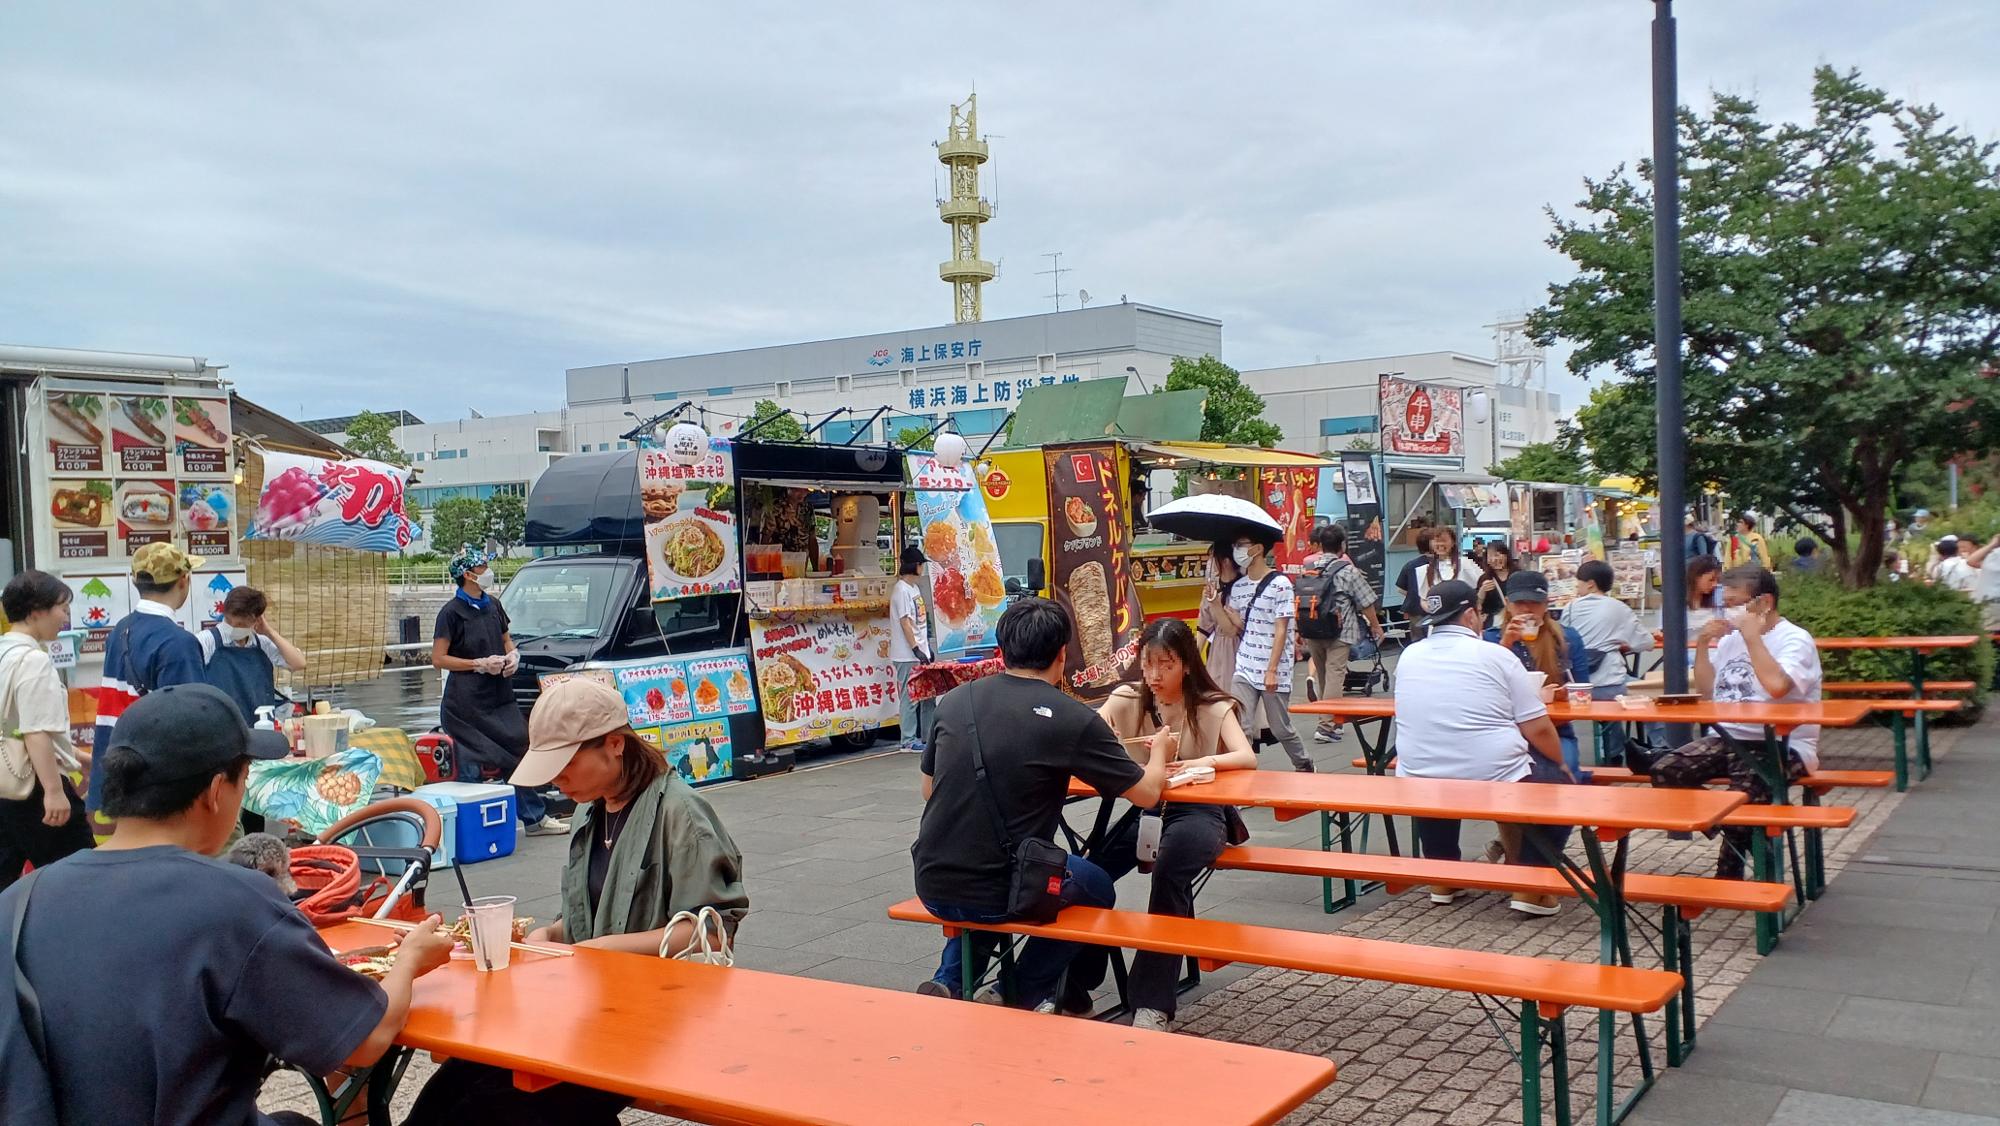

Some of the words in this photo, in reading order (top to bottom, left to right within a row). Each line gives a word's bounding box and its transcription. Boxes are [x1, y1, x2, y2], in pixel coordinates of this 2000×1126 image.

[872, 349, 889, 358] JCG
[900, 338, 983, 364] 海上保安庁
[1409, 395, 1430, 431] 牛串
[645, 465, 725, 480] 沖縄塩焼きそば
[1098, 461, 1129, 634] ドネルケバブ
[697, 660, 738, 671] アイスモンスター
[627, 667, 675, 678] アイスモンスター
[794, 680, 900, 718] 沖縄塩焼きそ
[699, 704, 721, 713] マンゴー
[728, 703, 748, 712] 700円
[669, 711, 691, 721] 700円
